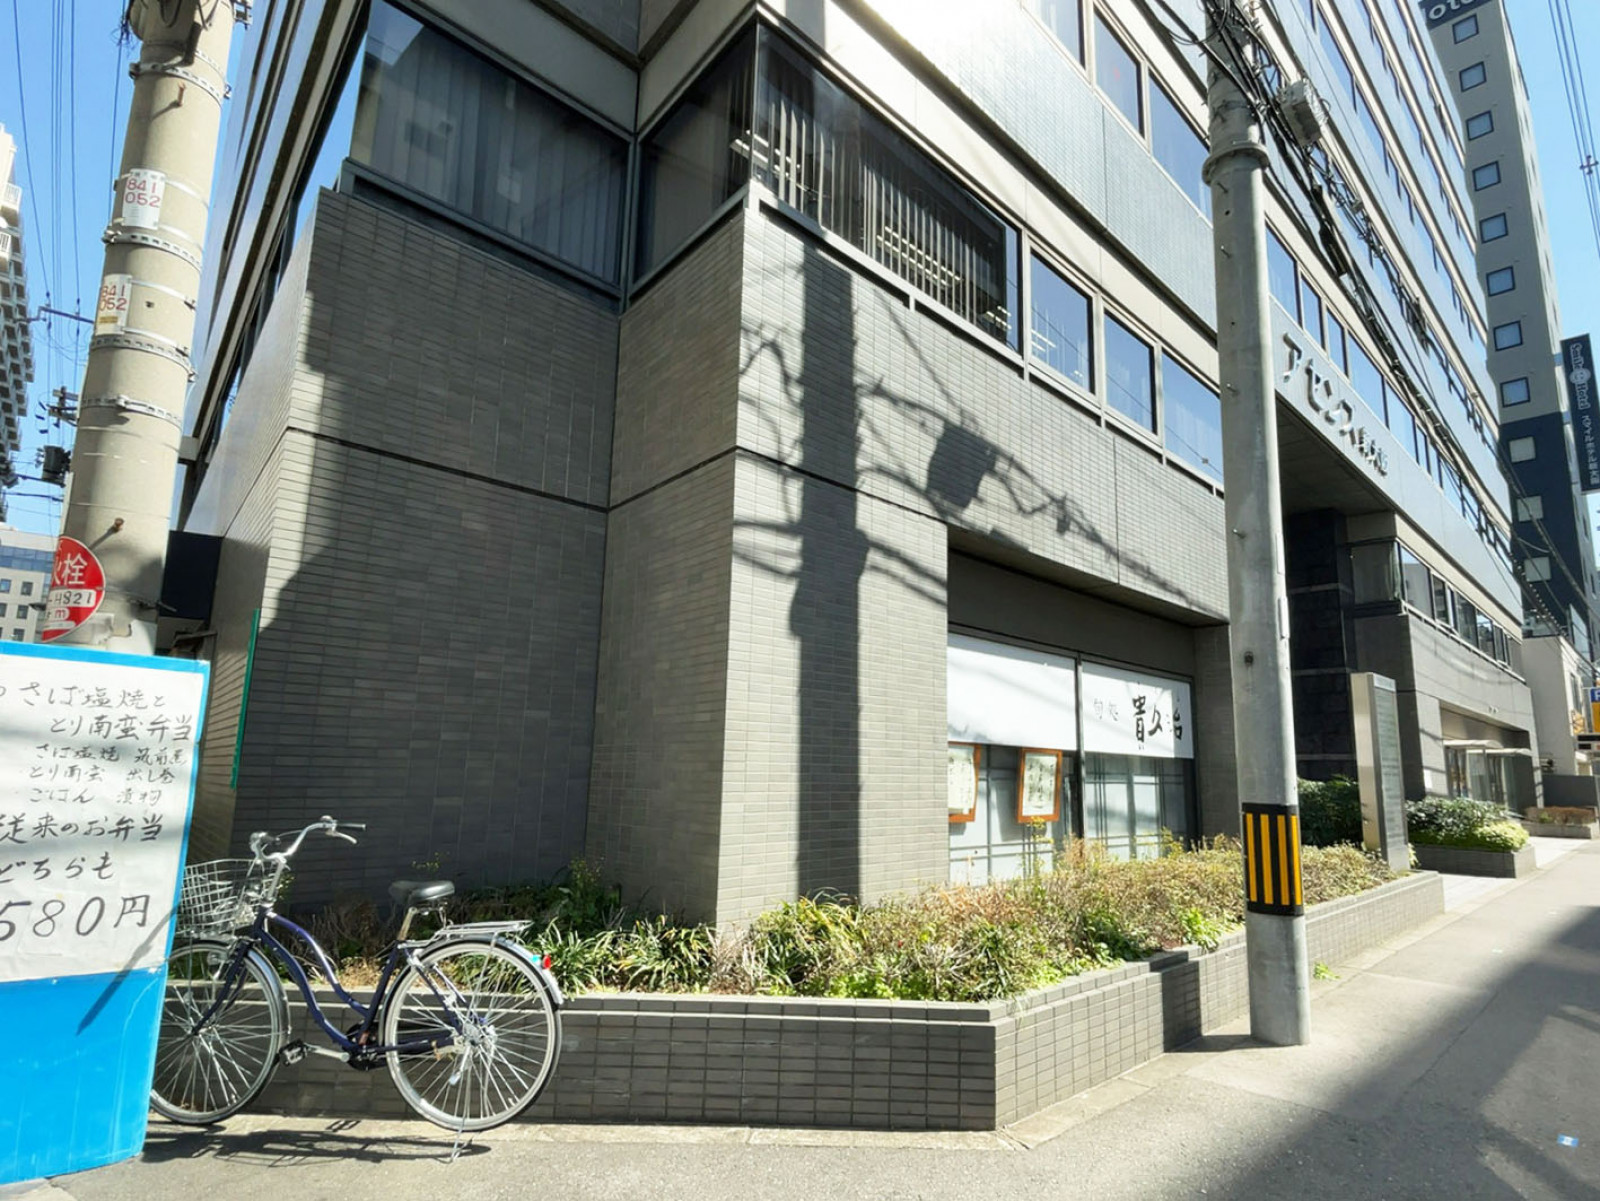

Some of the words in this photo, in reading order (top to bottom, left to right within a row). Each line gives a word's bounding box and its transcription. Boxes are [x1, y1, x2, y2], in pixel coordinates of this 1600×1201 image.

[1429, 0, 1476, 20] ot
[127, 176, 157, 194] 841
[125, 191, 161, 209] 052
